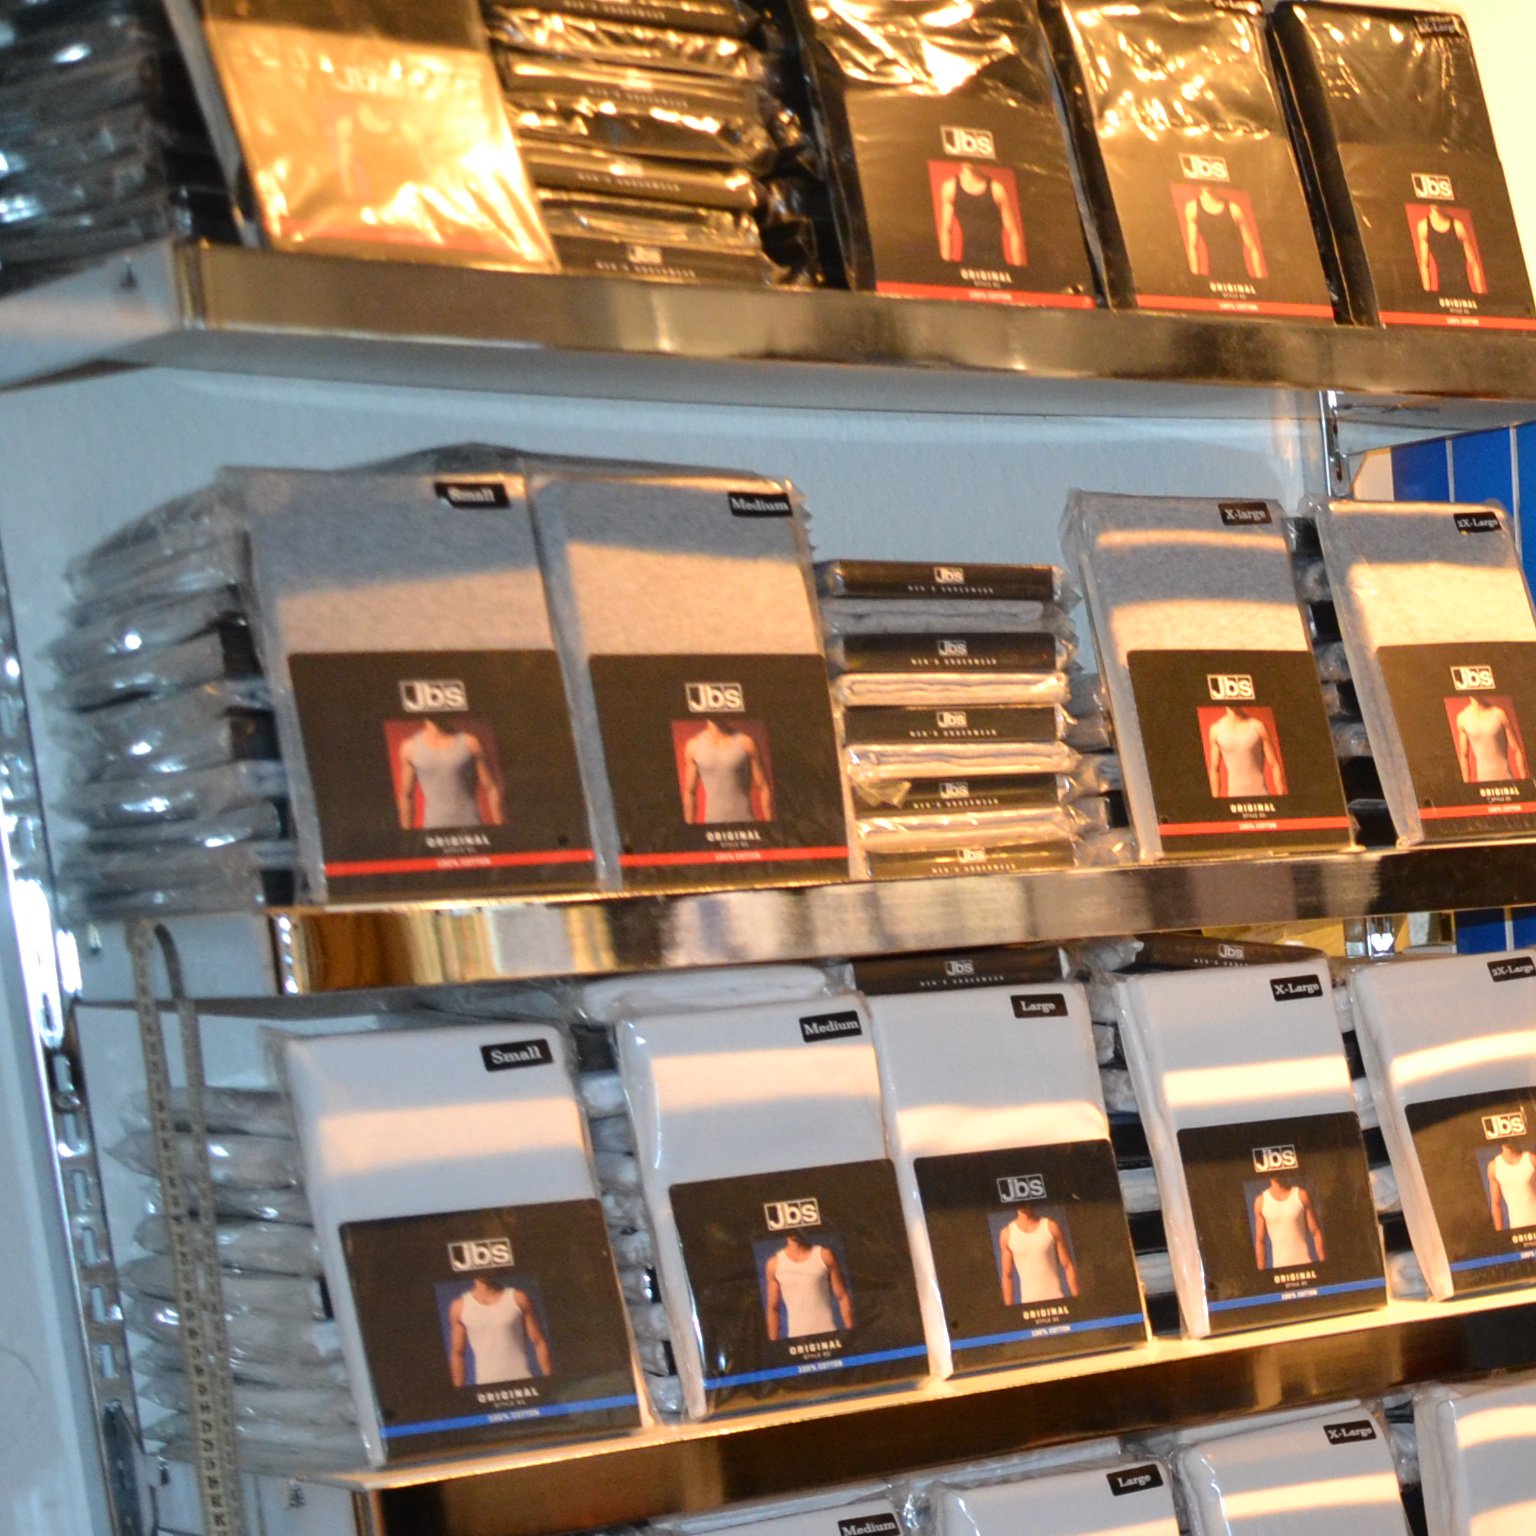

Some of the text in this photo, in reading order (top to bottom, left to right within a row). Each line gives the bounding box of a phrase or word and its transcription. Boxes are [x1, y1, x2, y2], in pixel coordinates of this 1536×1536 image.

[732, 497, 789, 511] Medium
[1491, 964, 1533, 977] 2X-Large
[1274, 980, 1319, 995] X-Large
[1020, 1000, 1056, 1013] Large
[804, 1020, 859, 1036] Medium
[491, 1045, 542, 1064] Small
[1273, 1270, 1317, 1284] ORIGINAL
[1023, 1305, 1070, 1320] ORIGINAL
[789, 1340, 842, 1356] ORIGINAL
[1330, 1427, 1372, 1440] X-Large
[1117, 1474, 1151, 1488] Large
